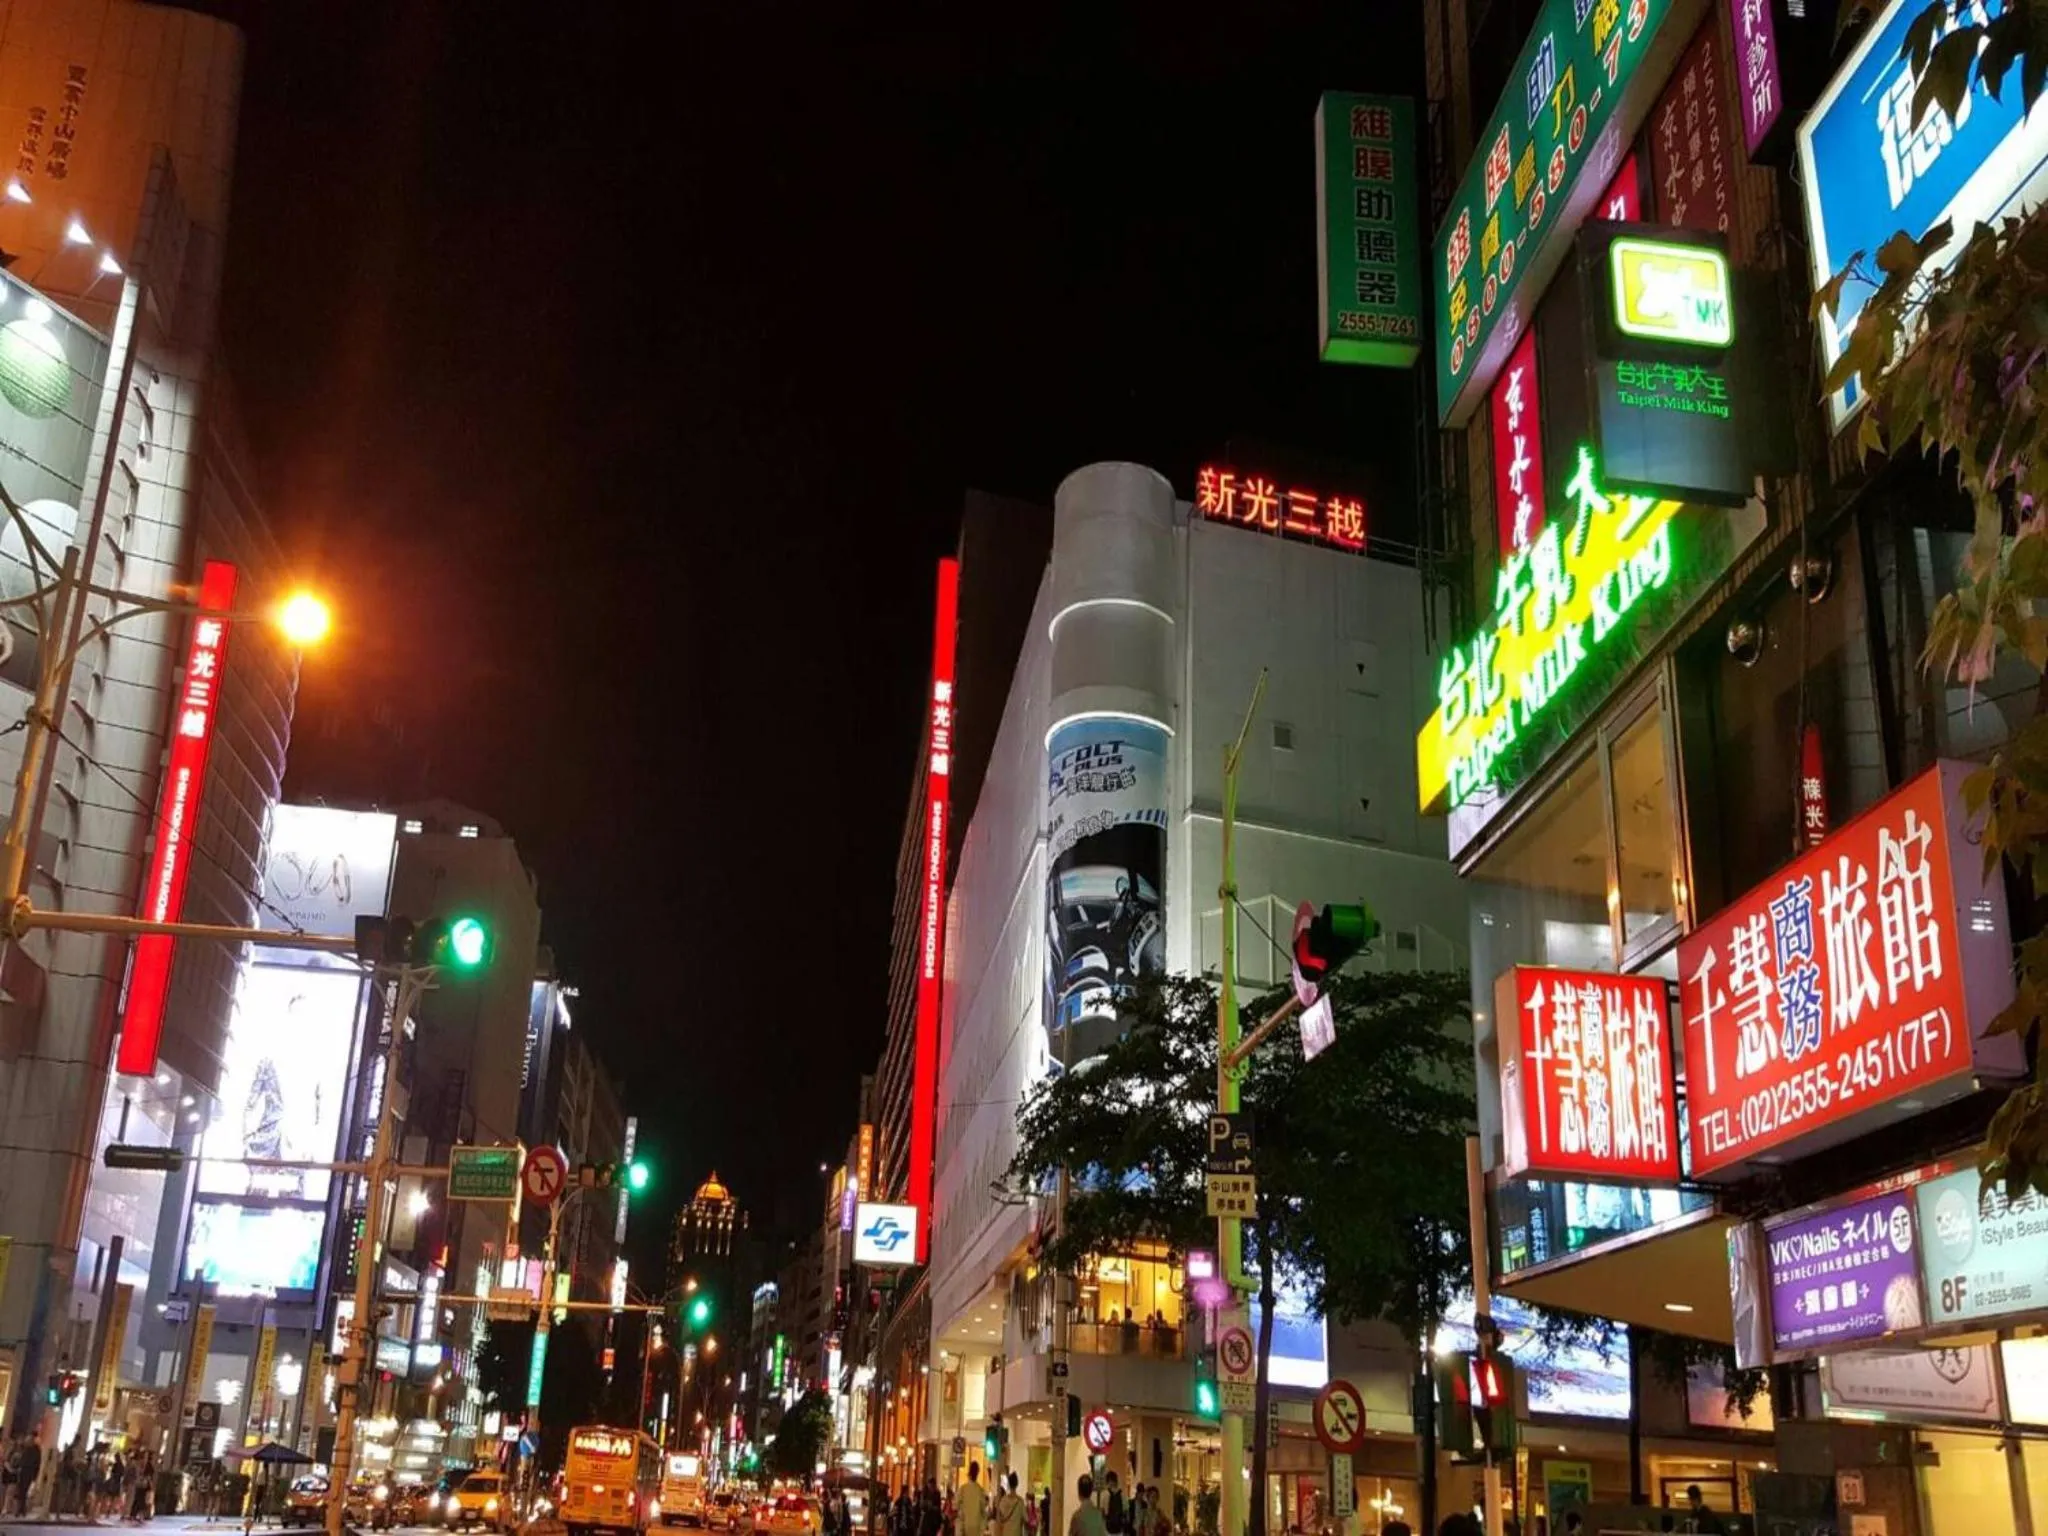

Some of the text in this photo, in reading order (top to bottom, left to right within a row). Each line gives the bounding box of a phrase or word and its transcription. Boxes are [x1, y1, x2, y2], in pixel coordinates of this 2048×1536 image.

[1338, 311, 1415, 335] 2555-7241
[1616, 360, 1729, 400] 台北牛乳大王
[1618, 391, 1730, 418] Taipei Milk King
[1199, 467, 1366, 548] 新光三越
[179, 622, 222, 738] 新光三越
[1445, 520, 1672, 807] Taipei Milk King
[930, 680, 952, 776] 新光三越
[1074, 755, 1123, 775] PLUS
[1210, 1117, 1230, 1153] P
[1842, 1210, 1888, 1248] ネイル
[1940, 1276, 1967, 1313] 8F
